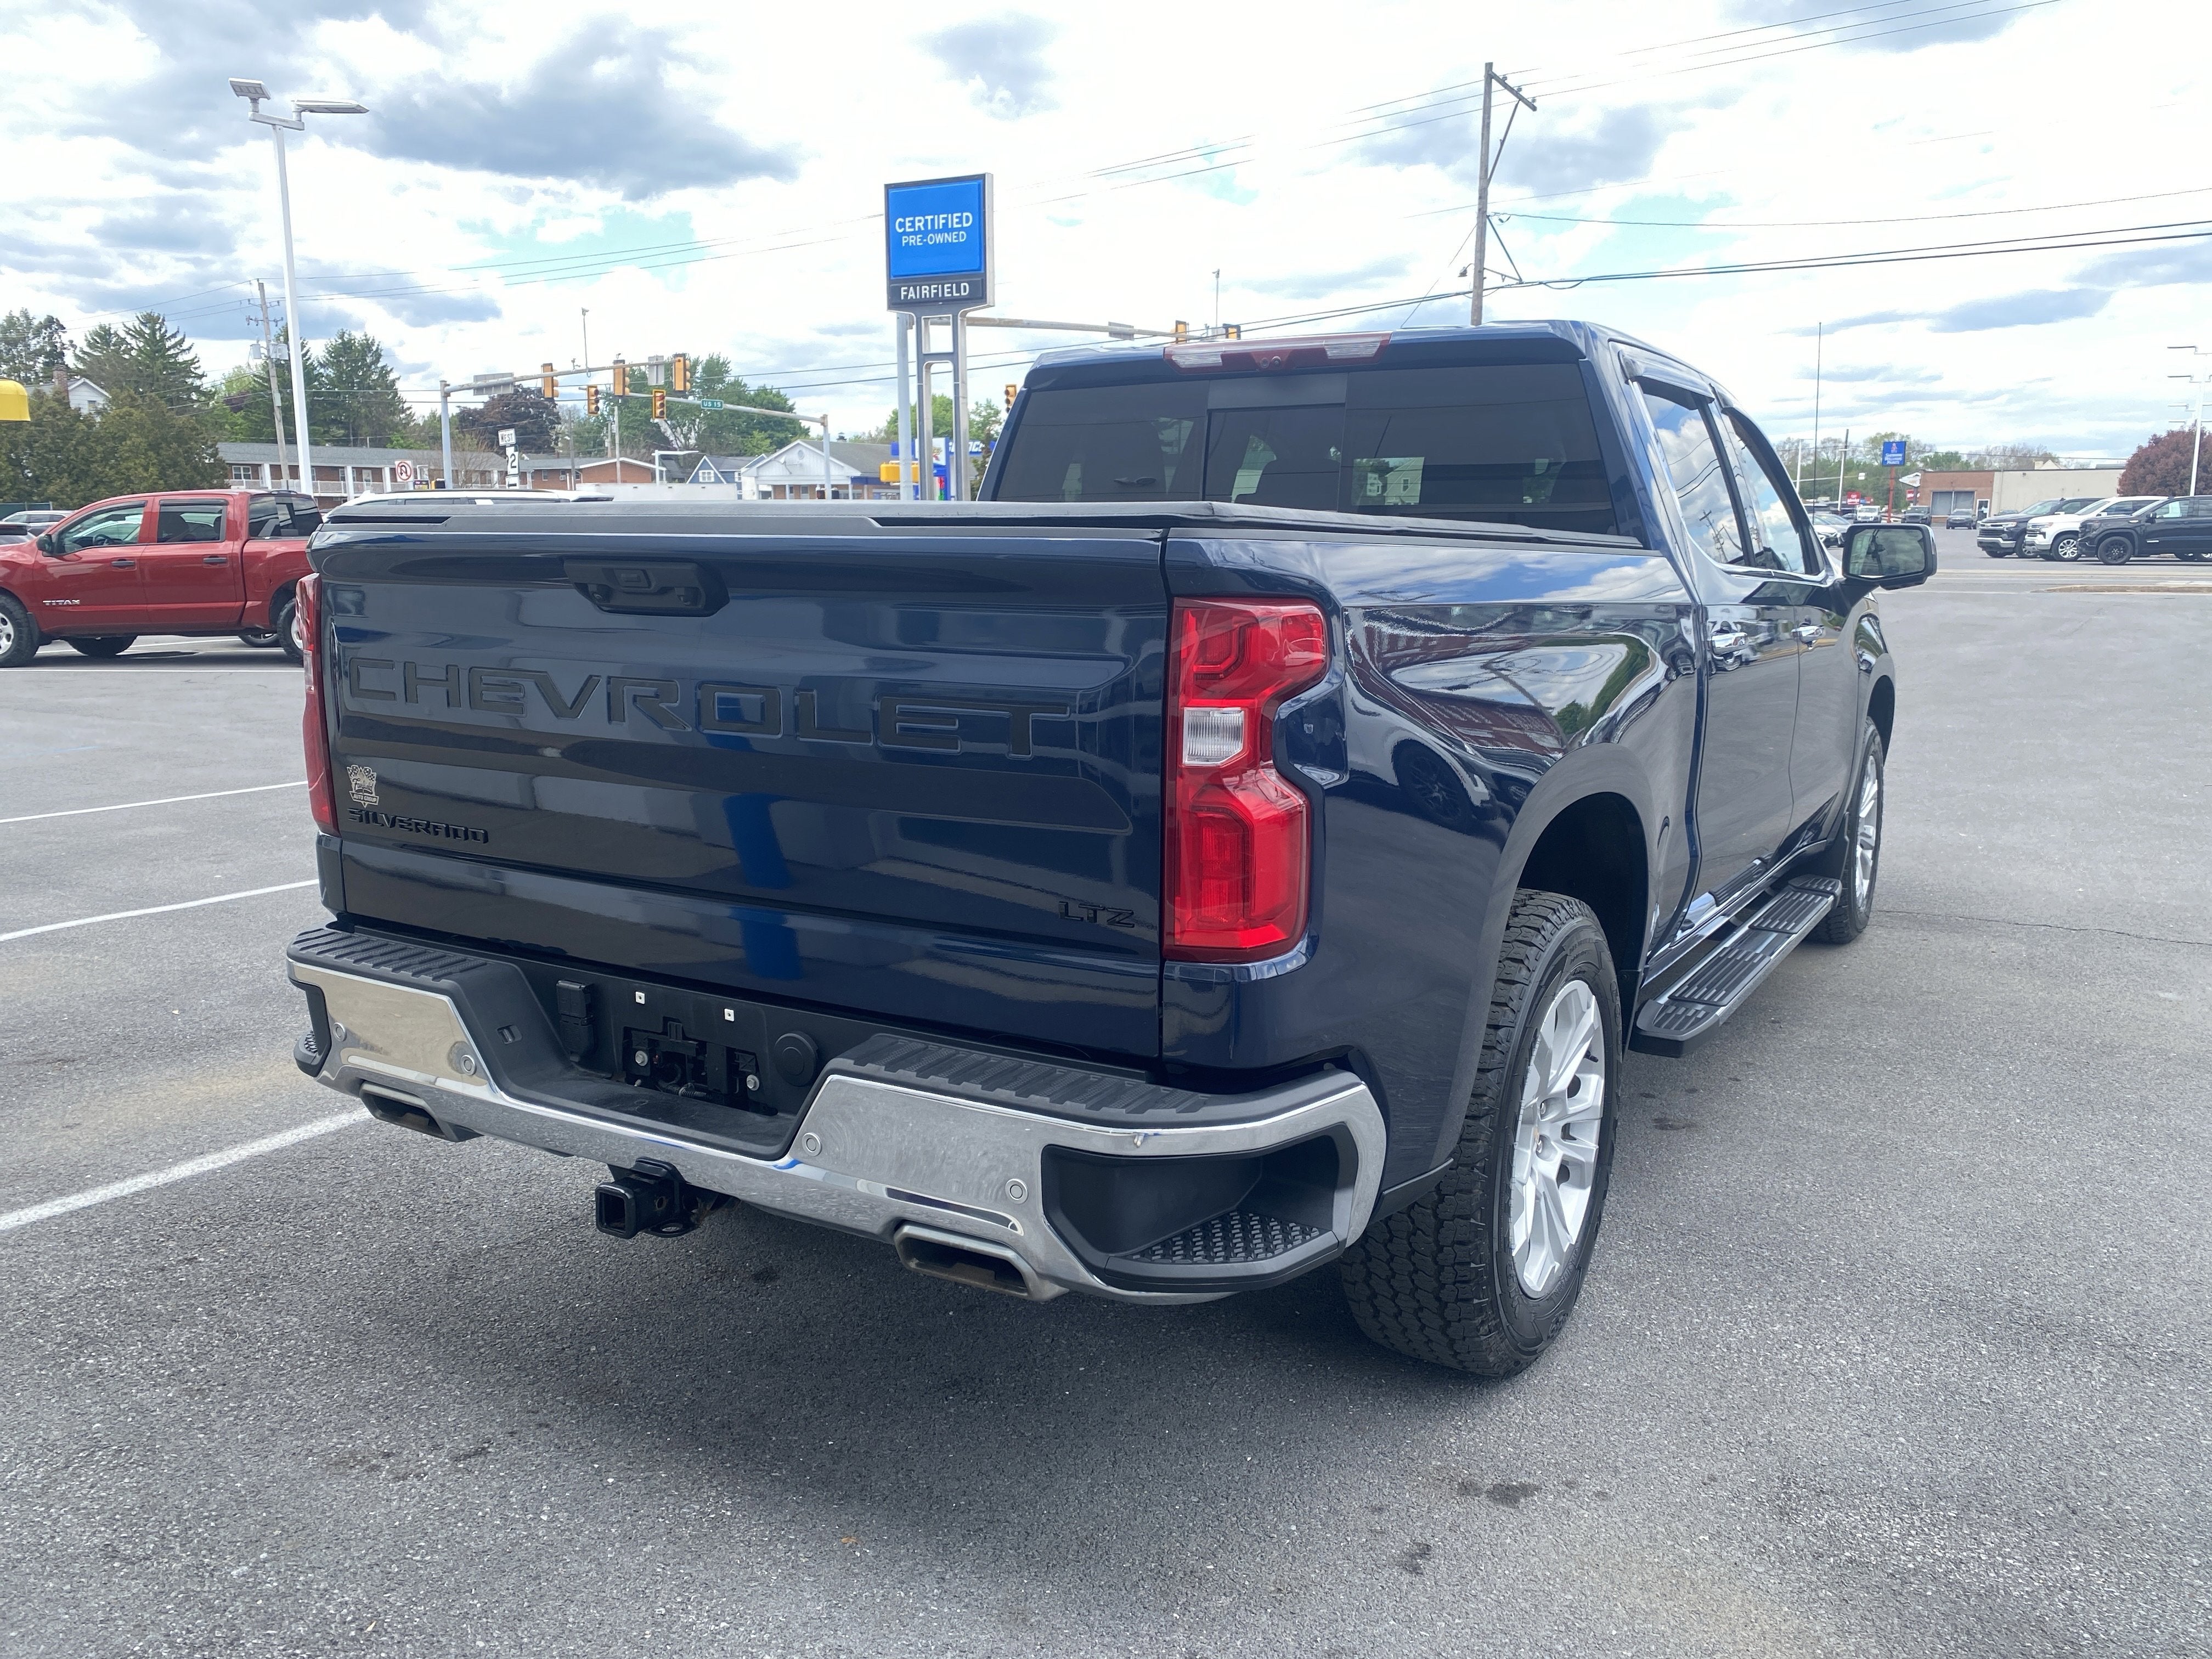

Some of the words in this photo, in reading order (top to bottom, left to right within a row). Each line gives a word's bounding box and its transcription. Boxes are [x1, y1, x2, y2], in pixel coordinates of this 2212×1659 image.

[895, 212, 973, 233] CERTIFIED
[902, 231, 967, 247] PRE-OWNED
[901, 283, 969, 300] FAIRFIELD
[500, 433, 513, 443] WEST
[349, 658, 1070, 760] CHEVROLET
[347, 808, 489, 844] SILVERADO
[1059, 901, 1135, 928] LTZ
